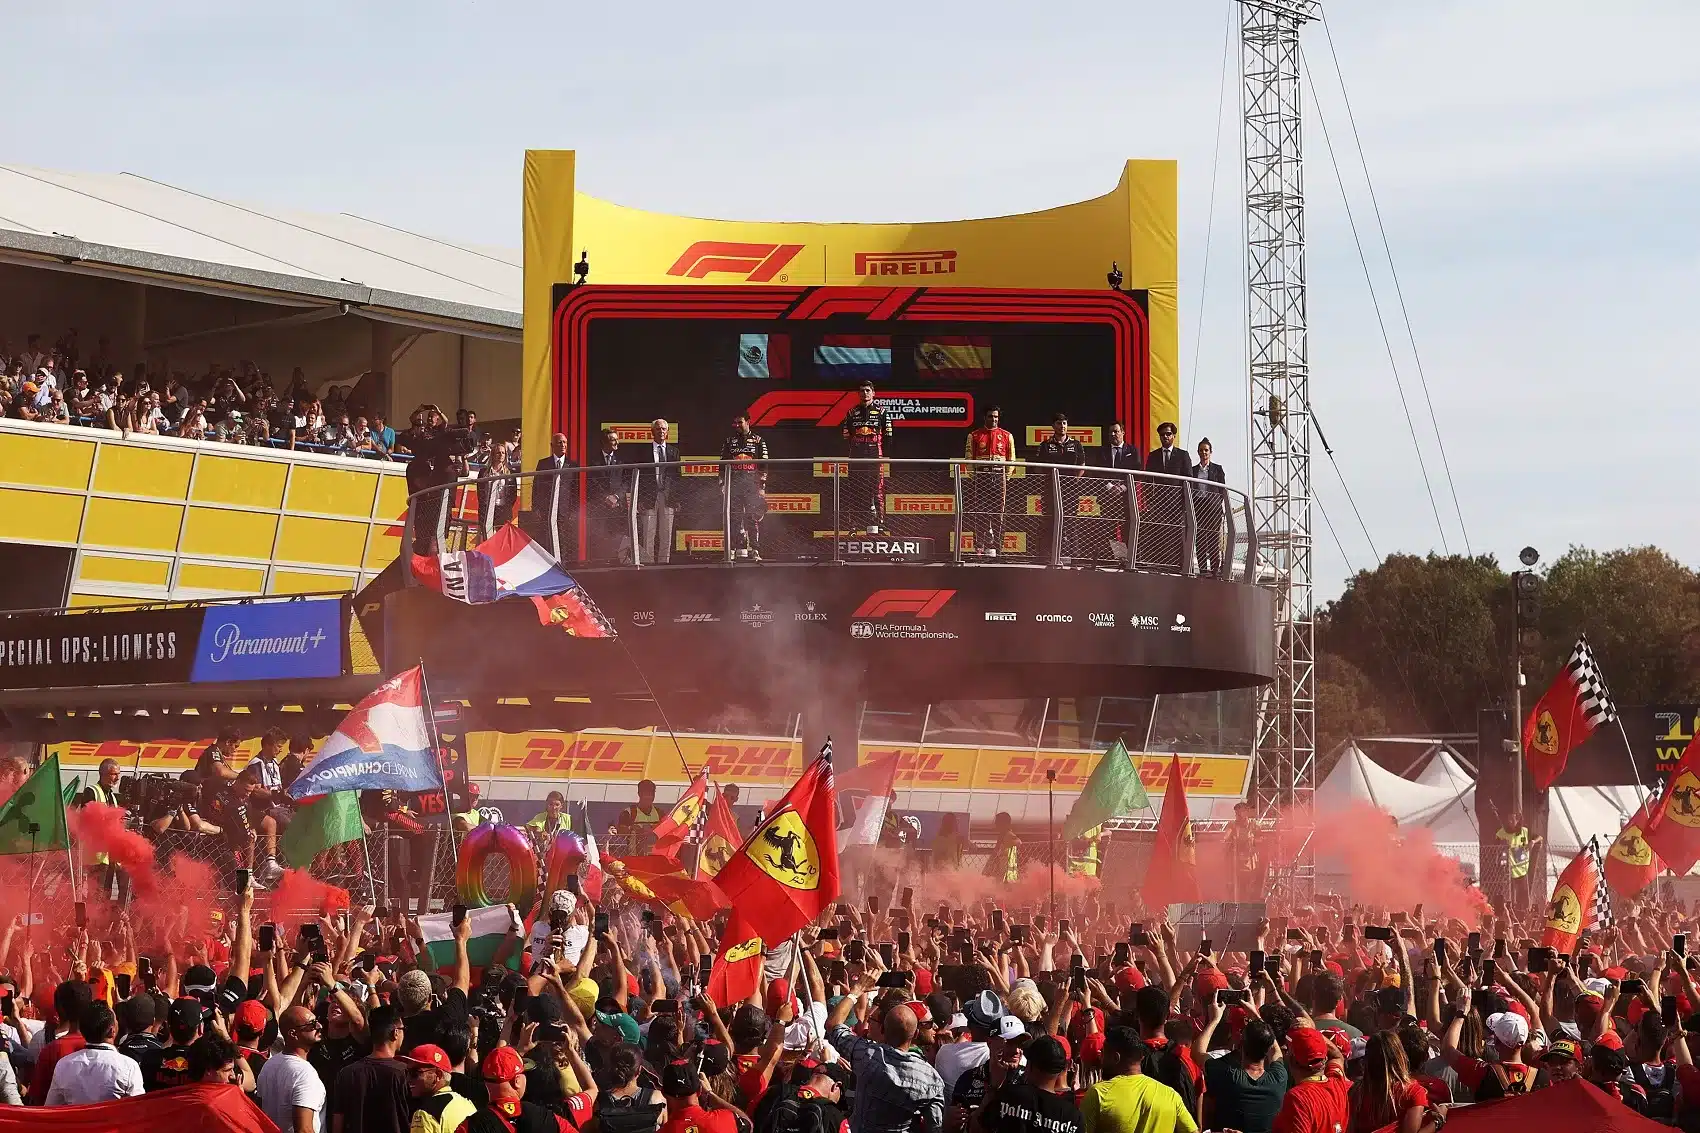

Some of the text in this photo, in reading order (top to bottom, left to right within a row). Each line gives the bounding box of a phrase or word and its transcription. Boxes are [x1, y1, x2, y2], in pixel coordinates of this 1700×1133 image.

[855, 250, 957, 276] PIRELLI
[765, 497, 811, 511] RELLI
[894, 498, 953, 512] PIRELLI
[838, 541, 920, 554] FERRARI
[633, 611, 655, 621] aws
[679, 613, 715, 623] DHL
[741, 612, 773, 621] Heineken
[794, 613, 828, 621] ROLEX
[985, 612, 1017, 621] PIRELLI
[1035, 614, 1073, 623] aramco
[1088, 612, 1115, 623] QATAR
[1140, 615, 1159, 626] MSC
[888, 623, 920, 632] Formula
[922, 624, 928, 632] 1
[1170, 624, 1191, 634] salesforce
[875, 631, 954, 640] World Championship
[210, 622, 327, 663] Paramount+
[521, 738, 627, 772] DHL
[698, 745, 792, 777] DHL
[1002, 756, 1084, 785] DHL
[418, 794, 445, 813] YES
